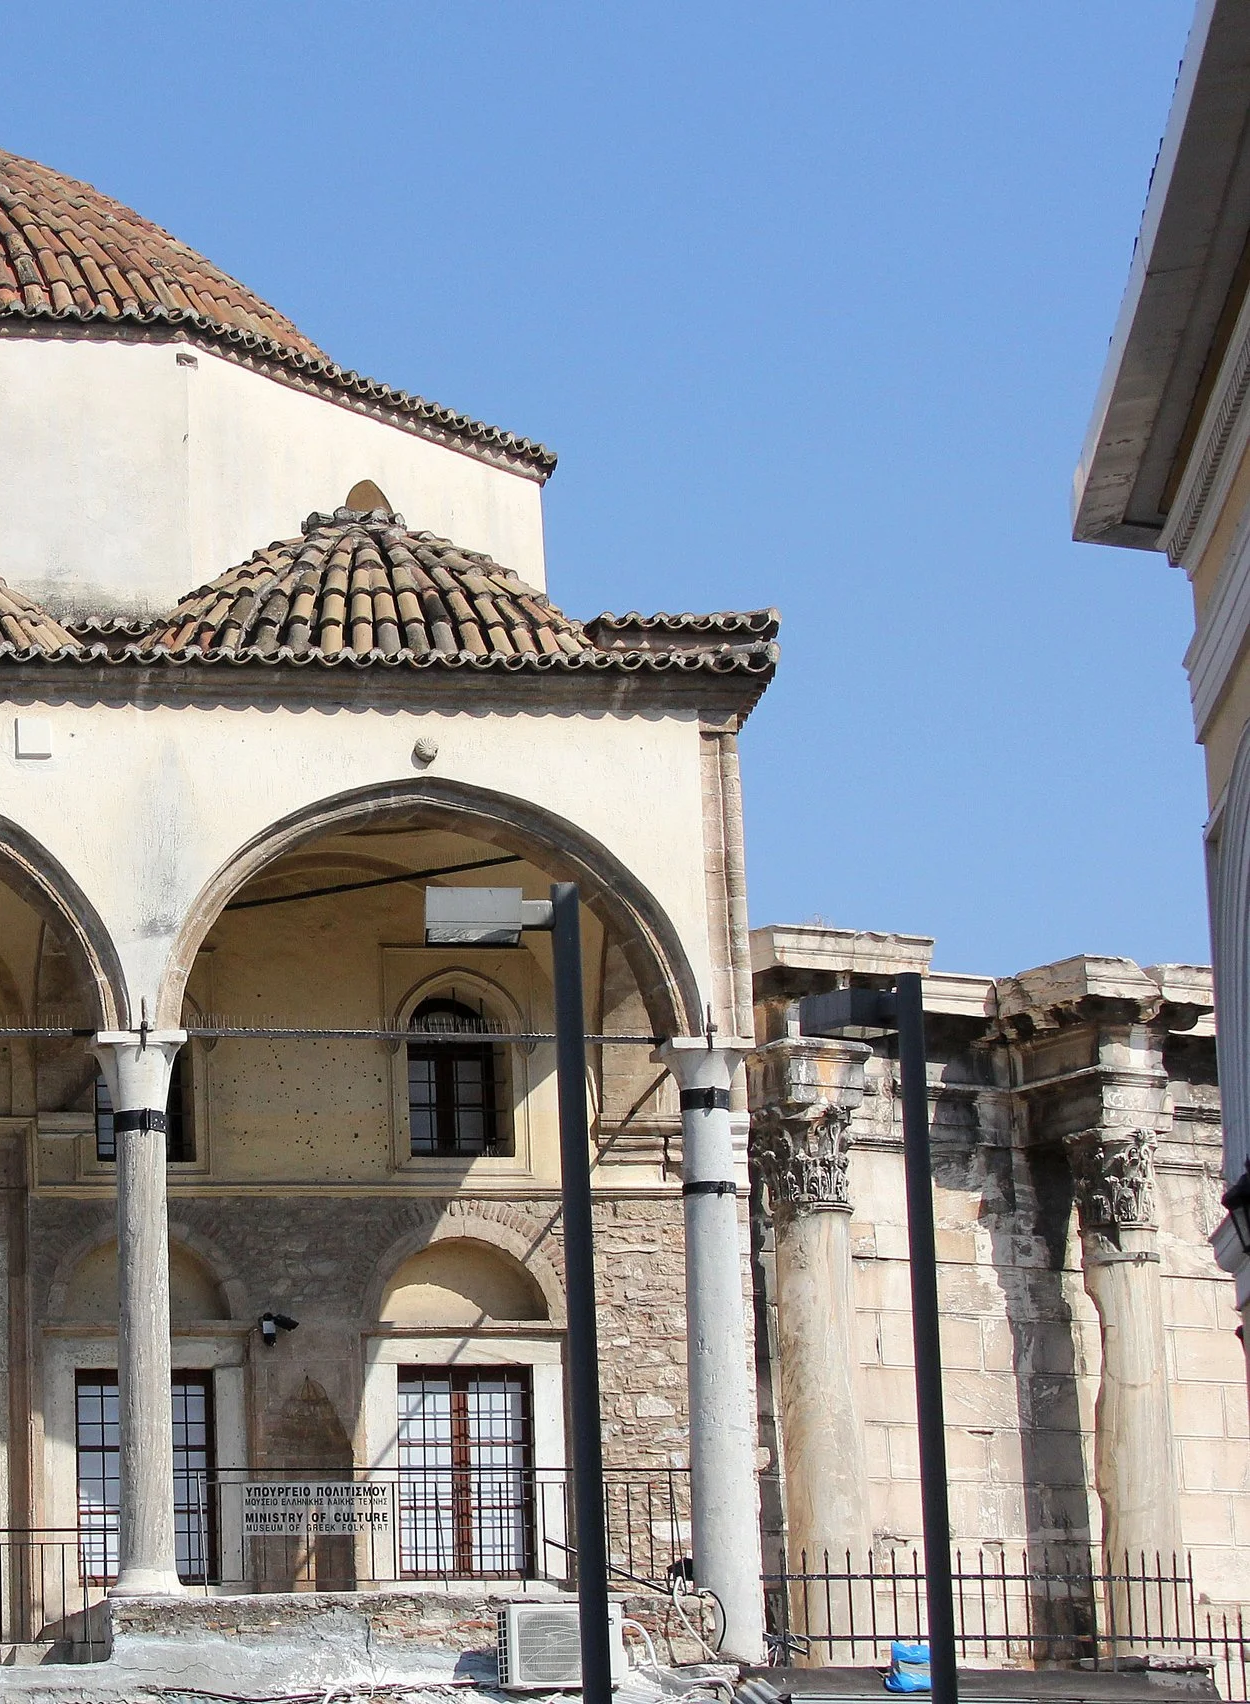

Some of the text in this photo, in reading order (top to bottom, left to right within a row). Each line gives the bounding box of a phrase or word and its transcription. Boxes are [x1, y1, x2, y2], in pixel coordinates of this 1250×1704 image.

[245, 1487, 387, 1497] ΥΠΟΥΡΓΕΙΟ ΠΟΛΙΤΙΣΜΟΥ
[245, 1498, 278, 1506] ΜΟΥΣΕΙΟ
[281, 1498, 324, 1506] ΕΛΛΗΝΙΚΗΣ
[359, 1498, 388, 1506] ΤΕΧΝΗΣ
[245, 1513, 388, 1522] MINISTRY OF CULTURE
[246, 1524, 388, 1532] MUSEUM OF GREEK FOLK ART
